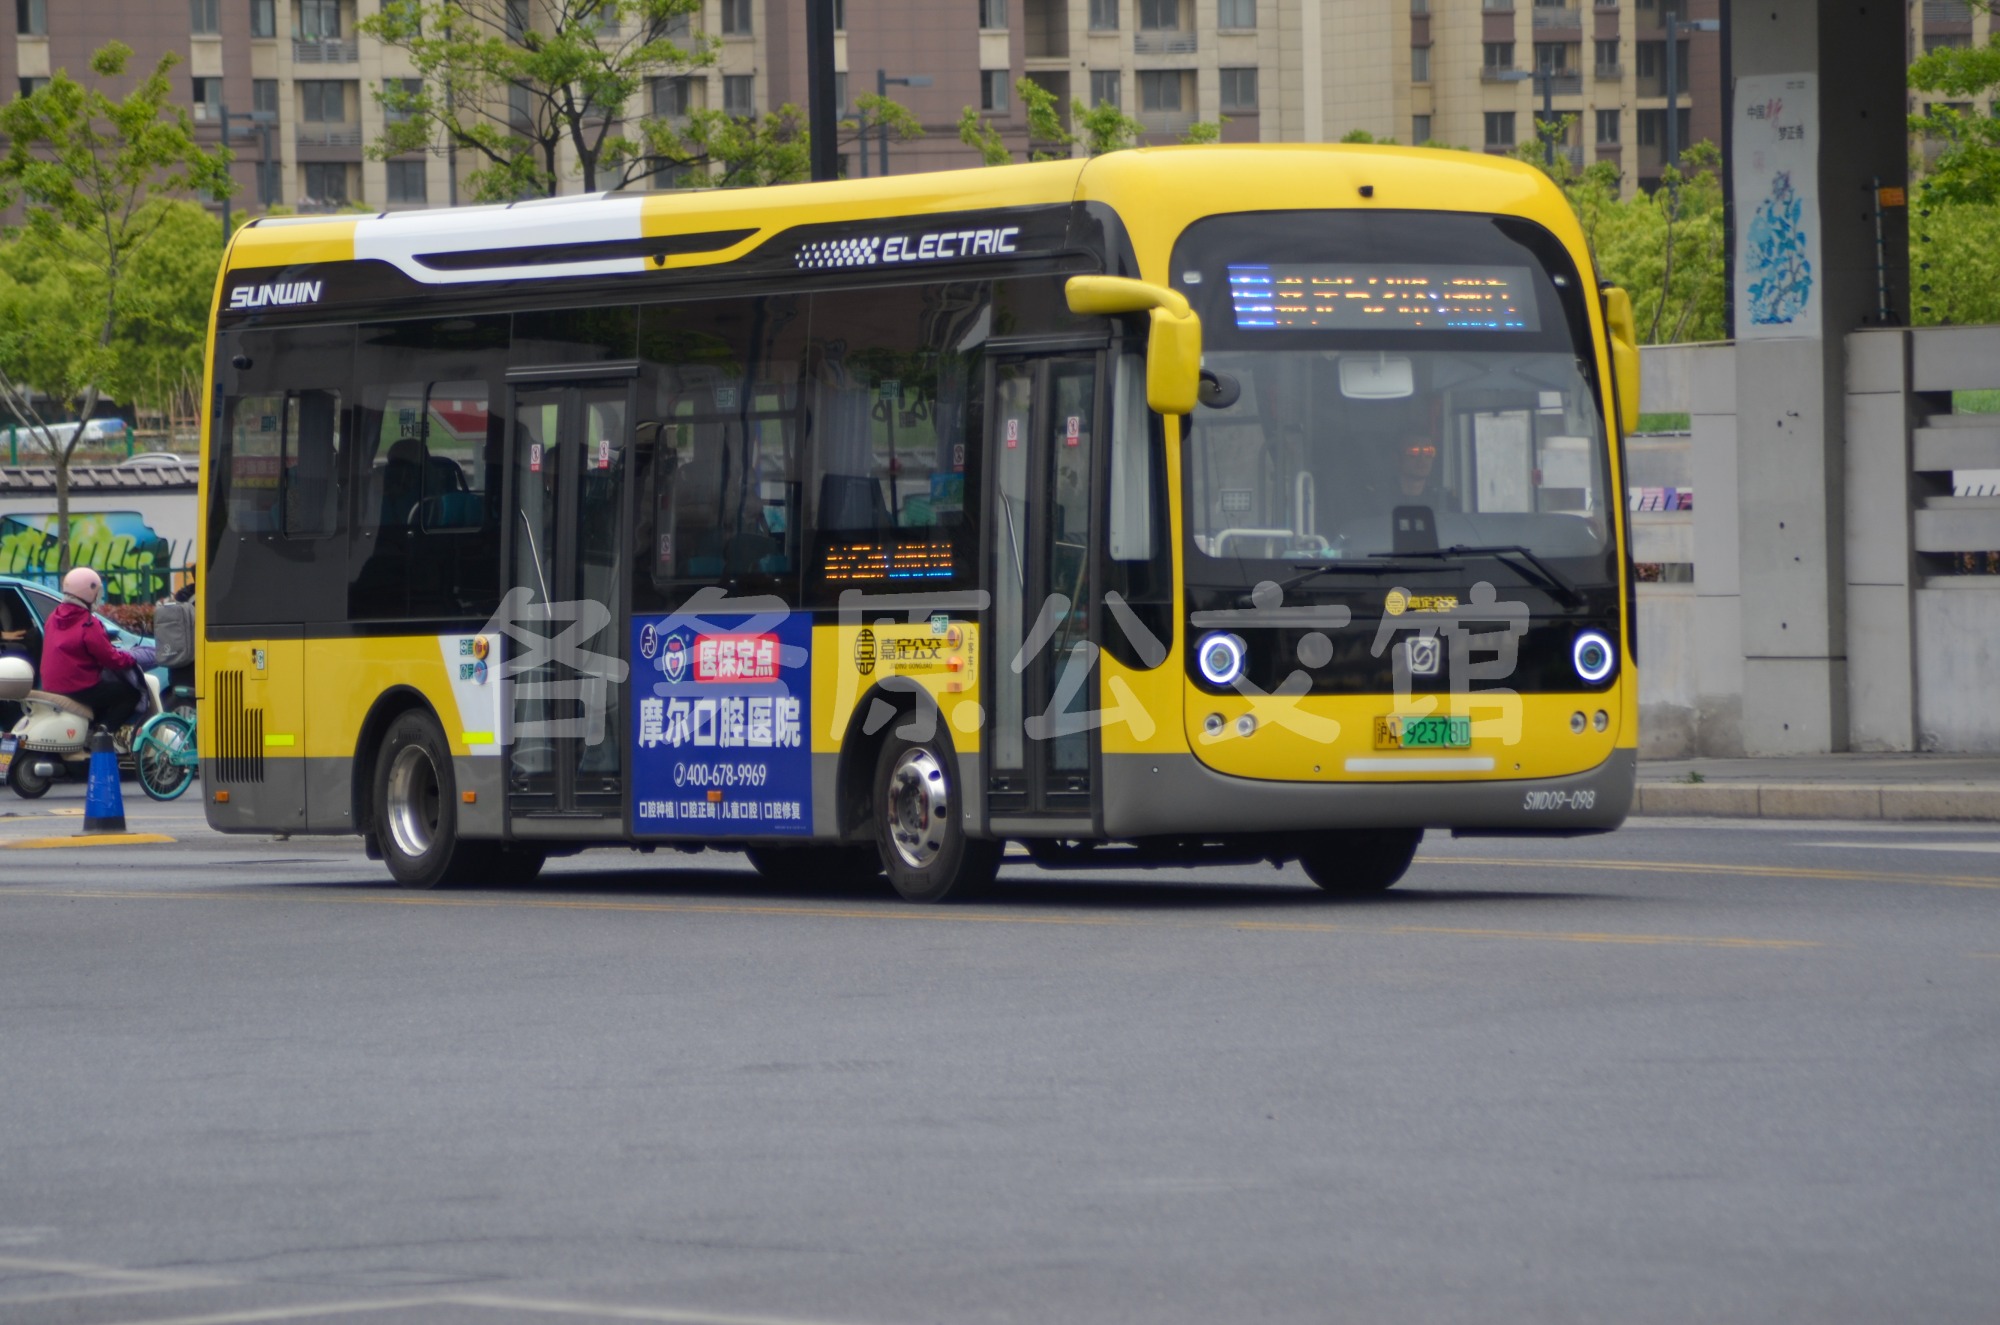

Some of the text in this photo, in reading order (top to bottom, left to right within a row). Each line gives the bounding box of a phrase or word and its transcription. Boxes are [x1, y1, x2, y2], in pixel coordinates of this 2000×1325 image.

[883, 227, 1018, 262] ELECTRIC
[229, 281, 321, 308] SUNWIN
[699, 639, 775, 678] 医保定点
[880, 638, 942, 660] 嘉定公交
[638, 697, 801, 748] 摩尔口腔医院
[686, 764, 767, 787] 400-678-9969
[1523, 790, 1596, 810] SWD09-098
